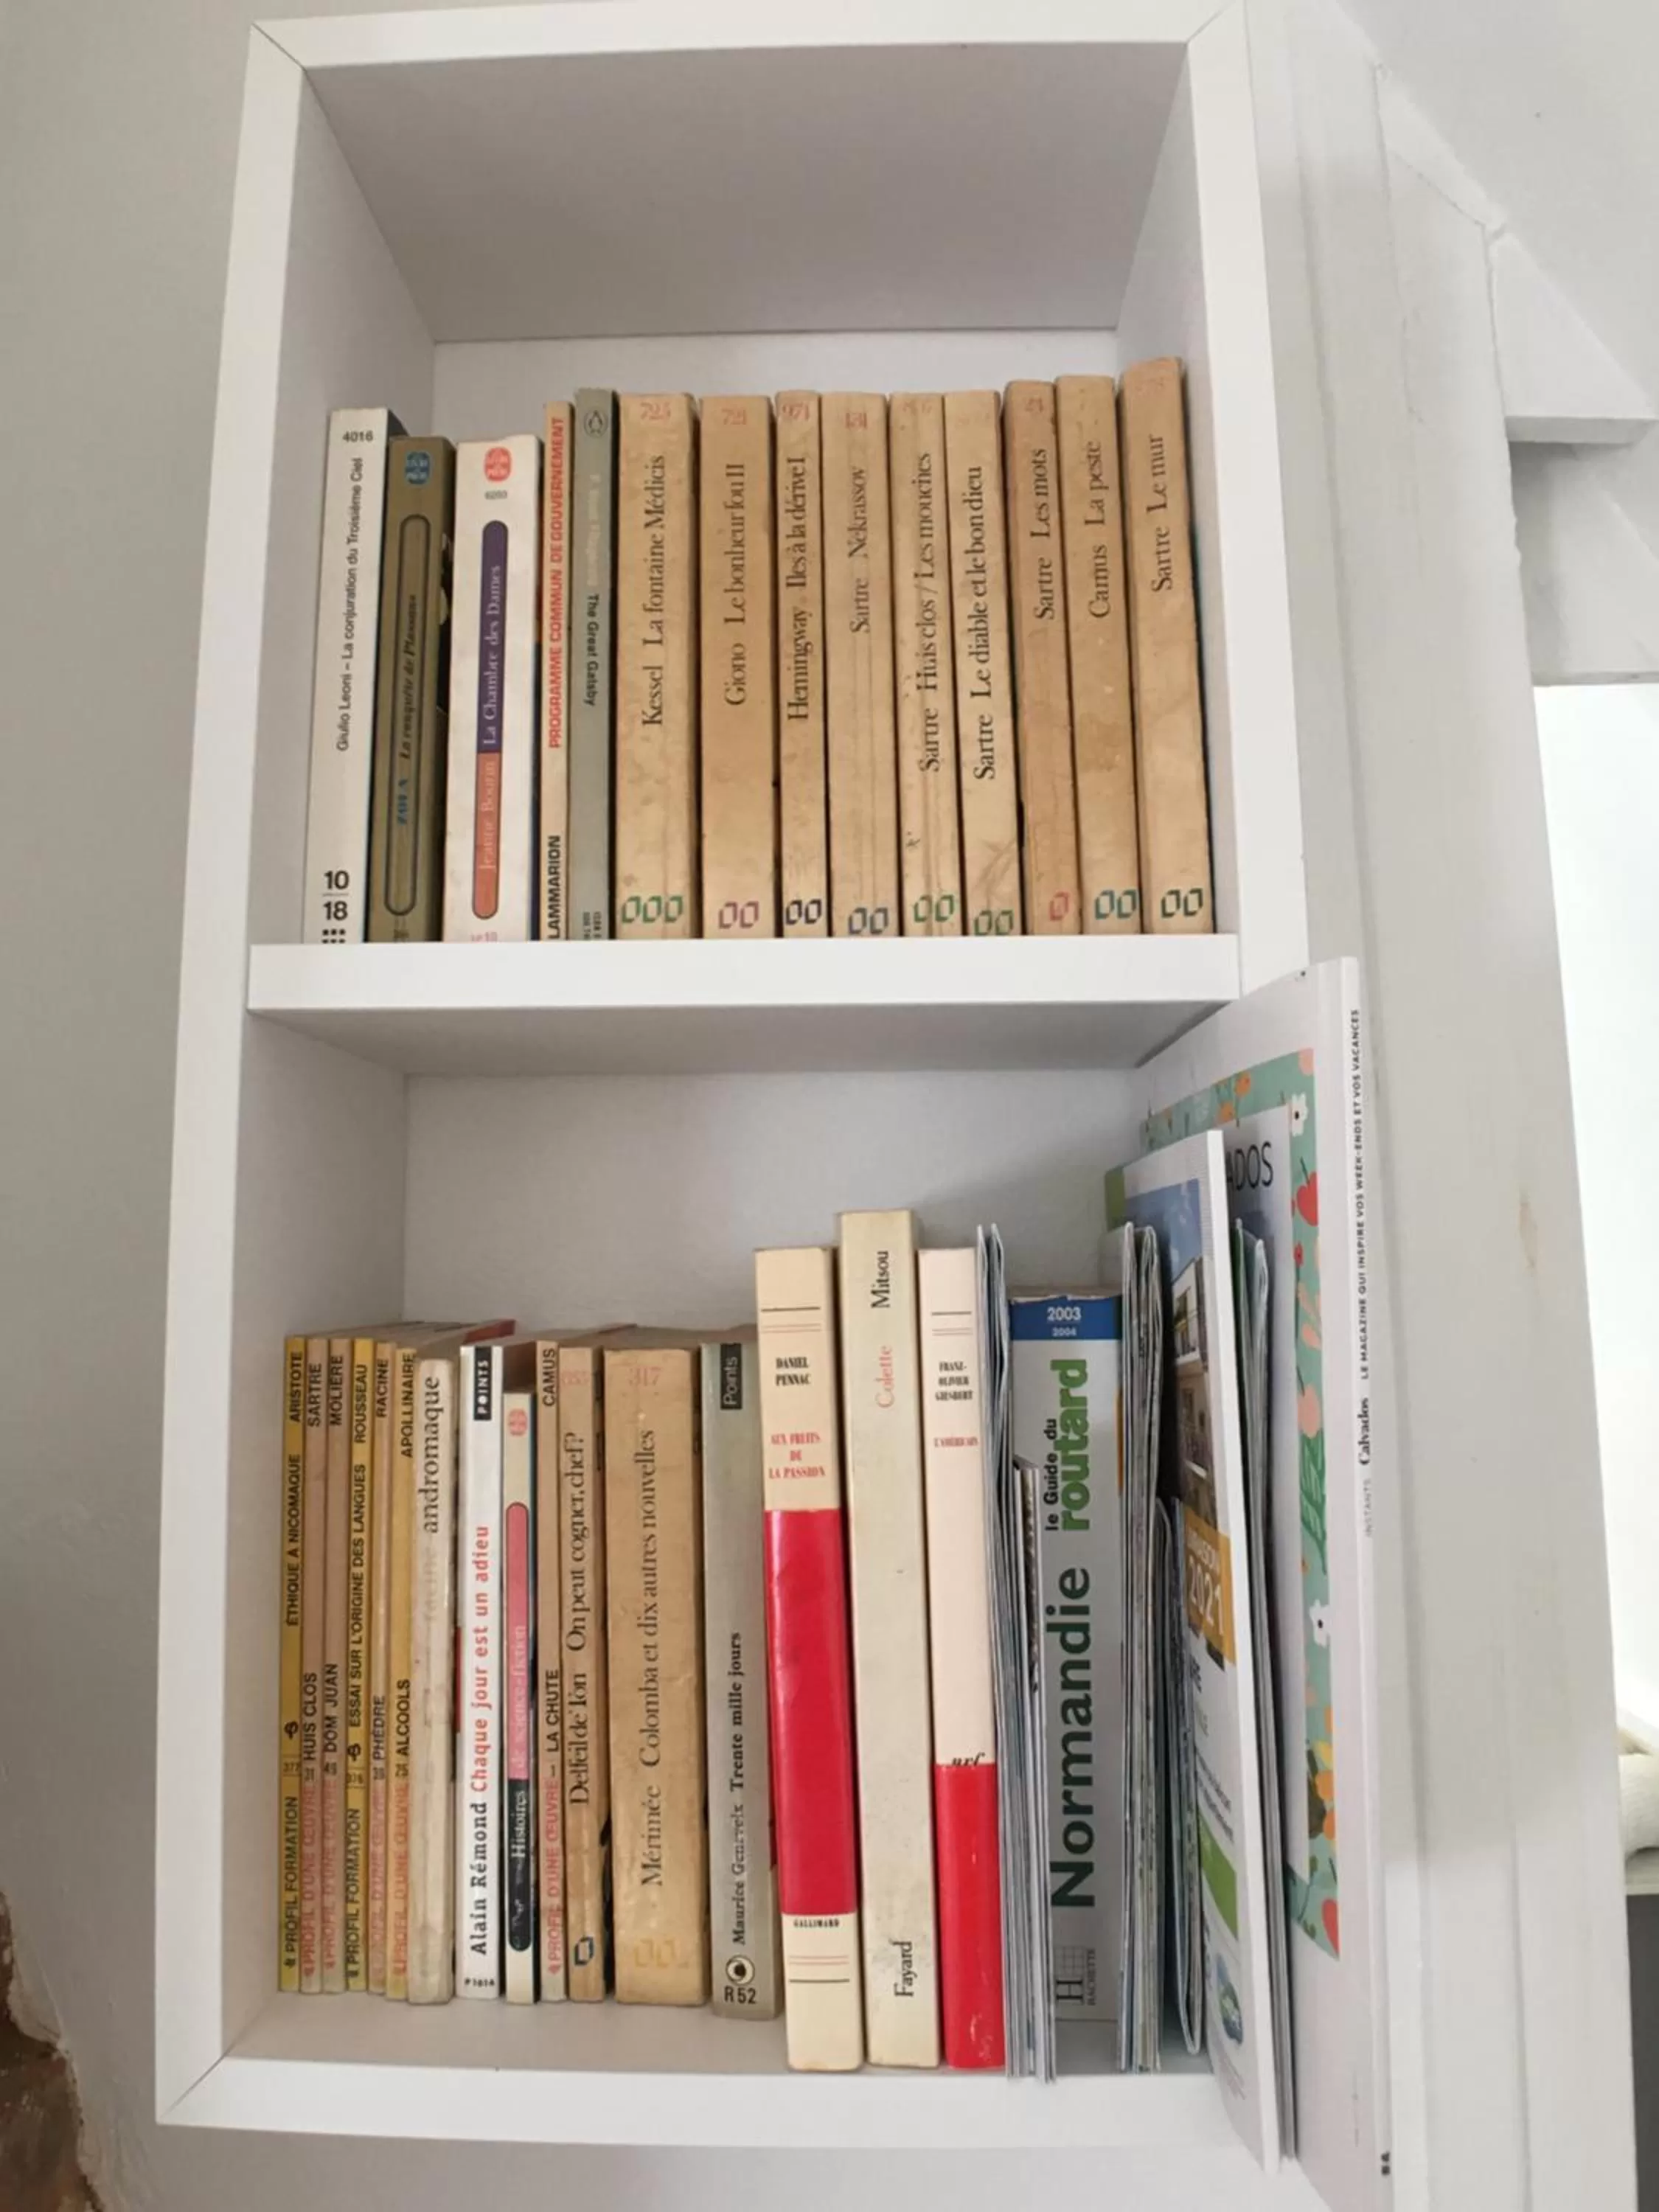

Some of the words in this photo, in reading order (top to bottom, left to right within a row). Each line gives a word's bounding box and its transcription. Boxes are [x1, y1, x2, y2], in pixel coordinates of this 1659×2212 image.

[343, 431, 372, 442] 4016
[1147, 433, 1166, 475] mur
[349, 457, 362, 484] Ciel
[551, 417, 565, 541] GOUVERNEMENT
[962, 466, 985, 510] dieu
[1031, 447, 1051, 497] mots
[1084, 439, 1111, 490] peste
[346, 489, 361, 543] Troisième
[642, 455, 665, 529] Médicis
[724, 481, 745, 512] fou
[784, 466, 807, 520] dérive
[849, 465, 869, 558] Nekrassov
[915, 452, 936, 538] mouches
[1085, 496, 1106, 525] La
[1146, 480, 1169, 512] Le
[785, 524, 806, 540] la
[964, 514, 987, 554] bon
[1030, 501, 1052, 538] Les
[345, 547, 358, 564] du
[550, 543, 563, 562] DE
[642, 533, 665, 612] fontaine
[724, 518, 745, 593] bonheur
[790, 542, 806, 552] à
[915, 542, 936, 578] Les
[966, 557, 987, 575] le
[1150, 526, 1174, 591] Sartre
[343, 568, 360, 639] conjuration
[486, 564, 501, 615] Dames
[550, 568, 563, 641] COMMUN
[585, 594, 598, 618] The
[849, 577, 870, 633] Sartre
[970, 578, 988, 597] et
[1033, 556, 1056, 619] Sartre
[1088, 543, 1113, 618] Camus
[484, 620, 501, 644] des
[643, 619, 663, 645] La
[725, 597, 745, 624] Le
[917, 598, 938, 638] clos
[967, 602, 991, 664] diable
[341, 642, 354, 658] La
[585, 622, 599, 660] Great
[787, 606, 813, 720] Hemingway
[917, 641, 939, 692] Huis
[338, 673, 353, 709] Leoni
[484, 650, 499, 720] Chambre
[549, 646, 563, 748] PROGRAMME
[583, 664, 598, 705] Gatsby
[643, 664, 663, 725] Kessel
[725, 641, 746, 705] Giono
[971, 667, 992, 698] Le
[336, 712, 352, 751] Giulio
[482, 724, 496, 743] La
[919, 706, 941, 772] Sartre
[973, 714, 996, 779] Sartre
[323, 870, 350, 890] 10
[548, 835, 561, 939] LAMMARION
[322, 900, 349, 921] 18
[1350, 1008, 1361, 1070] VACANCES
[1352, 1073, 1362, 1096] VOS
[1353, 1099, 1362, 1114] ET
[1353, 1117, 1365, 1189] WEEK-ENDS
[1356, 1192, 1366, 1216] VOS
[1356, 1220, 1366, 1268] INSPIRE
[870, 1250, 890, 1307] Mitsou
[1357, 1272, 1367, 1293] QUI
[1047, 1306, 1082, 1322] 2003
[1052, 1326, 1077, 1338] 2004
[1358, 1297, 1368, 1360] MAGAZINE
[290, 1351, 302, 1422] ARISTOTE
[376, 1358, 389, 1417] RACINE
[477, 1359, 488, 1413] POINTS
[543, 1347, 556, 1406] CAMUS
[721, 1355, 738, 1405] Points
[776, 1357, 809, 1368] DANIEL
[776, 1374, 811, 1386] PENNAC
[874, 1345, 894, 1408] Colette
[1359, 1363, 1368, 1380] LE
[307, 1363, 321, 1427] SARTRE
[355, 1363, 366, 1443] ROUSSEAU
[401, 1352, 414, 1458] APOLLINAIRE
[790, 1432, 821, 1444] FRUITS
[1043, 1417, 1057, 1439] du
[1049, 1358, 1091, 1531] routard
[1357, 1397, 1371, 1465] Calvados
[418, 1376, 442, 1533] andromaque
[565, 1432, 587, 1487] chef?
[633, 1428, 655, 1528] nouvelles
[783, 1465, 826, 1478] PASSION
[1043, 1451, 1060, 1505] Guide
[288, 1453, 301, 1543] NICOMAQUE
[352, 1464, 366, 1533] LANGUES
[1044, 1512, 1060, 1530] le
[571, 1489, 588, 1562] cogner,
[352, 1537, 364, 1566] DES
[473, 1525, 488, 1582] adieu
[638, 1533, 658, 1596] autres
[350, 1571, 364, 1644] L'ORIGINE
[475, 1592, 488, 1616] un
[570, 1568, 590, 1612] peut
[473, 1626, 488, 1657] est
[566, 1616, 586, 1651] On
[636, 1601, 658, 1635] dix
[351, 1649, 361, 1679] SUR
[640, 1641, 659, 1661] et
[729, 1632, 744, 1677] jours
[304, 1672, 316, 1716] CLOS
[325, 1663, 338, 1707] JUAN
[349, 1683, 361, 1727] ESSAI
[471, 1666, 492, 1709] jour
[546, 1669, 559, 1725] CHUTE
[728, 1682, 742, 1725] mille
[304, 1722, 316, 1760] HUIS
[325, 1716, 337, 1752] DOM
[396, 1678, 409, 1756] ALCOOLS
[546, 1730, 560, 1751] LA
[570, 1714, 588, 1737] de
[638, 1666, 661, 1767] Colomba
[1046, 1568, 1096, 1907] Normandie
[470, 1717, 490, 1791] Chaque
[568, 1739, 589, 1804] Delfeil
[730, 1733, 744, 1792] Trente
[285, 1795, 297, 1891] FORMATION
[470, 1801, 487, 1887] Rémond
[510, 1789, 527, 1857] Histoires
[640, 1784, 664, 1886] Mérimée
[347, 1808, 360, 1903] FORMATION
[285, 1895, 297, 1952] PROFIL
[347, 1907, 360, 1964] PROFIL
[470, 1898, 487, 1955] Alain
[732, 1879, 745, 1945] Maurice
[889, 1939, 917, 1997] Fayard
[1086, 1947, 1096, 2006] HACHETTE
